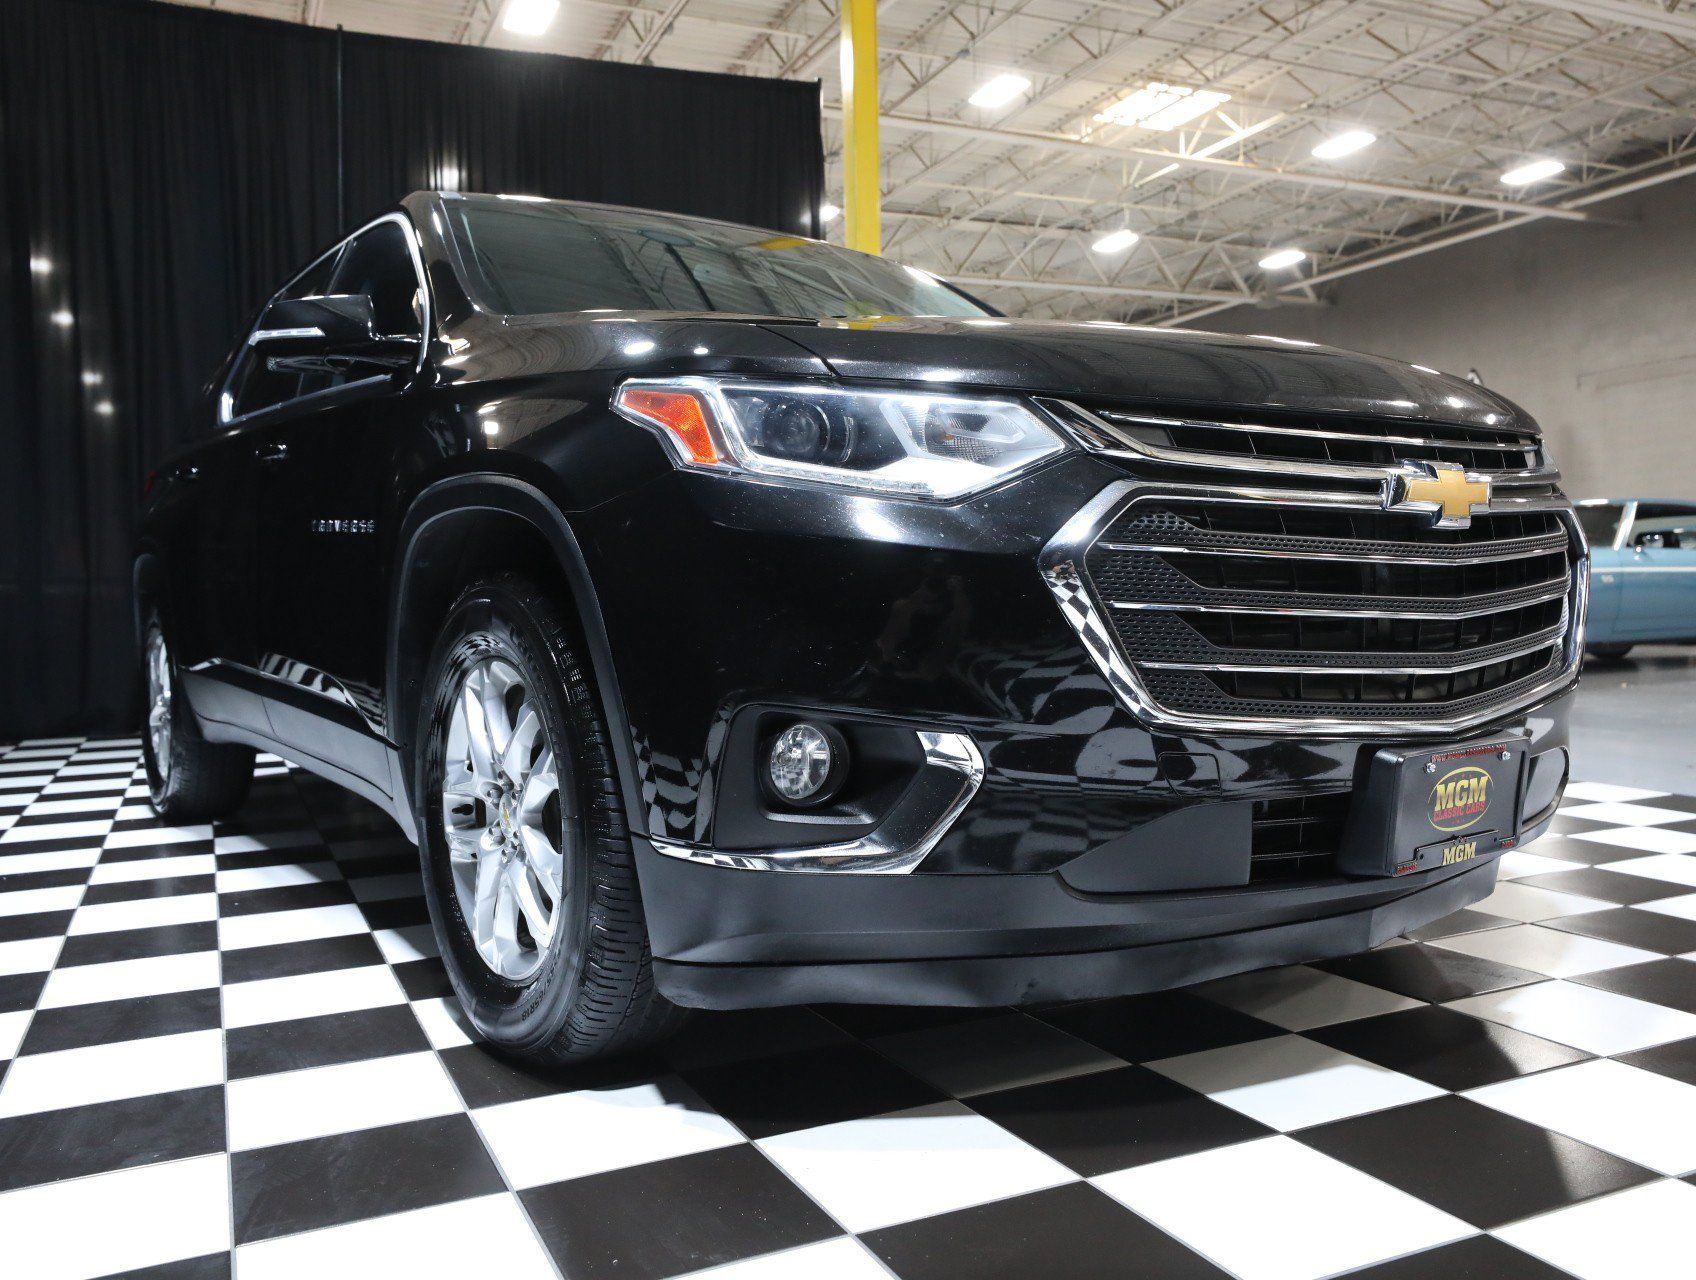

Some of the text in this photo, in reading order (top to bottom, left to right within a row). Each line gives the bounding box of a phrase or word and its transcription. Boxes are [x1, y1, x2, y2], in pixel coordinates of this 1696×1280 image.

[1435, 776, 1488, 811] MGM
[1433, 801, 1486, 821] CLASSIC CARS
[1442, 841, 1477, 866] MGM
